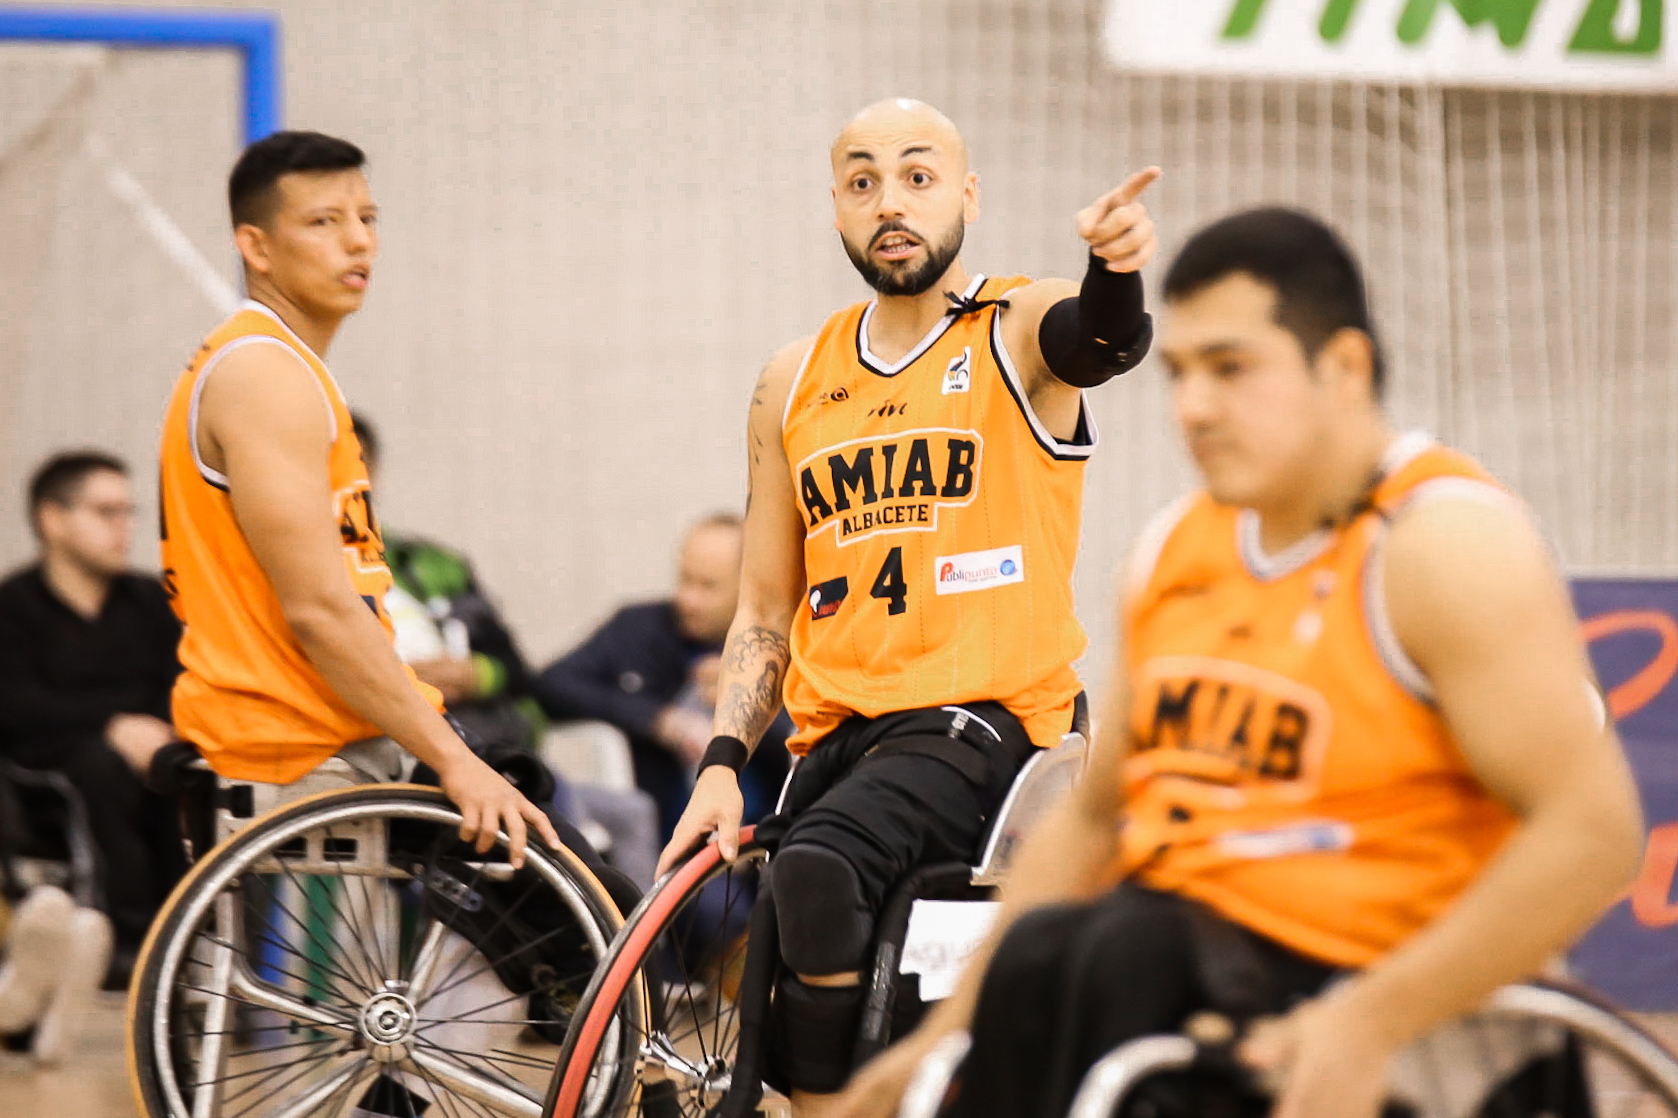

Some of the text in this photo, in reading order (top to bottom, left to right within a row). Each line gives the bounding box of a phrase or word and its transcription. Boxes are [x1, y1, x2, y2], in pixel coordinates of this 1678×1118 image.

[801, 439, 975, 526] AMIAB
[843, 504, 929, 536] ALBACETE
[870, 546, 907, 616] 4
